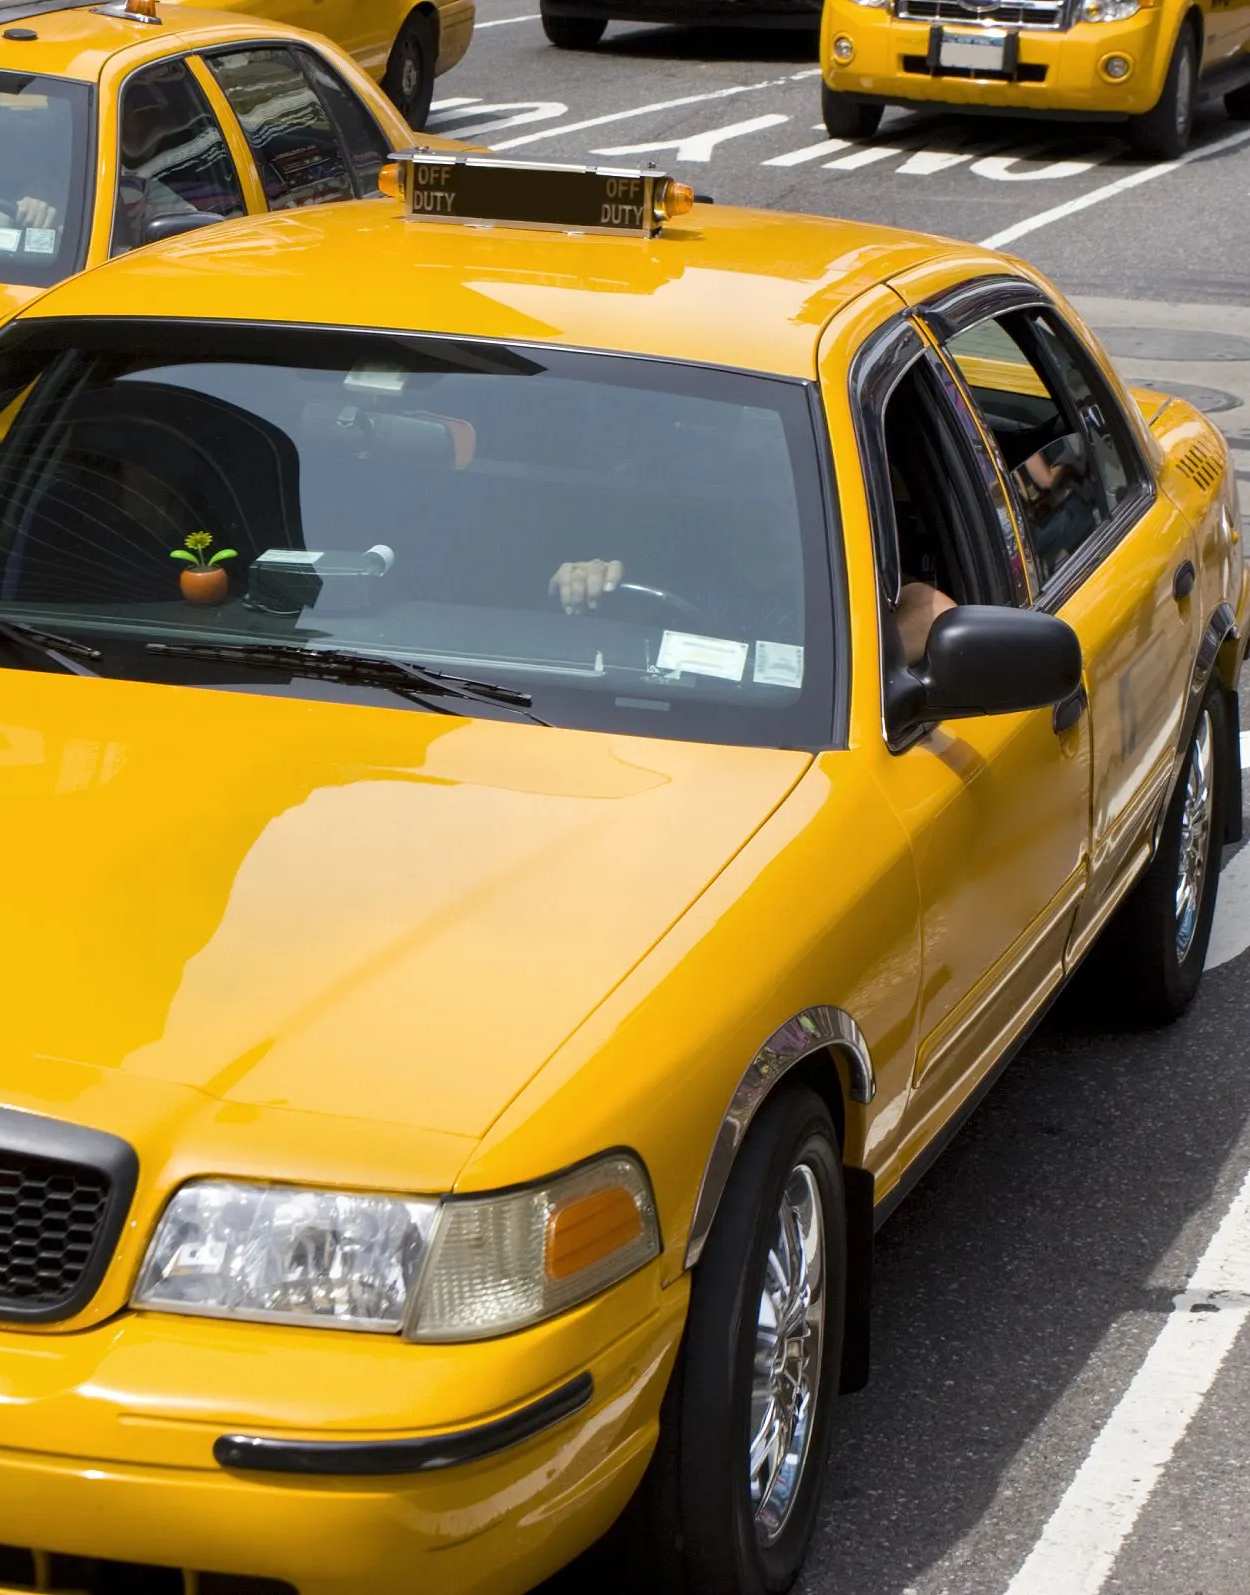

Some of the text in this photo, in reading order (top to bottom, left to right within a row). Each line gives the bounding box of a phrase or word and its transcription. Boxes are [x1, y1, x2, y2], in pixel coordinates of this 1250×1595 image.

[418, 165, 452, 186] OFF
[606, 178, 641, 199] OFF
[413, 190, 456, 212] DUTY
[601, 203, 644, 226] DUTY
